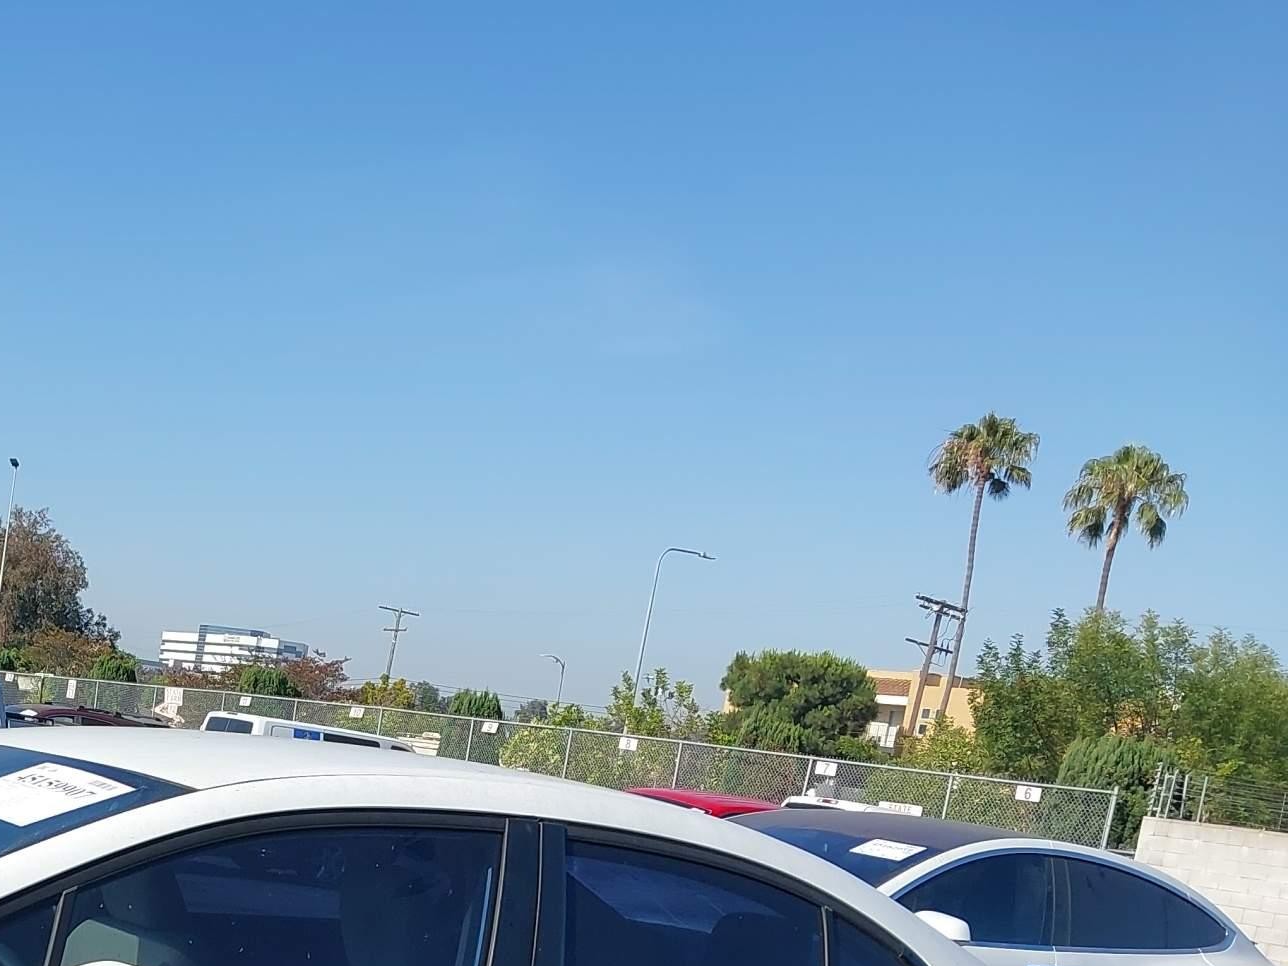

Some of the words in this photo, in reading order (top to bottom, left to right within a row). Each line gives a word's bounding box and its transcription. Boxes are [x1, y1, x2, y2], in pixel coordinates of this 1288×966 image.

[625, 739, 632, 749] 8
[824, 763, 831, 774] 7
[1024, 787, 1032, 800] 6
